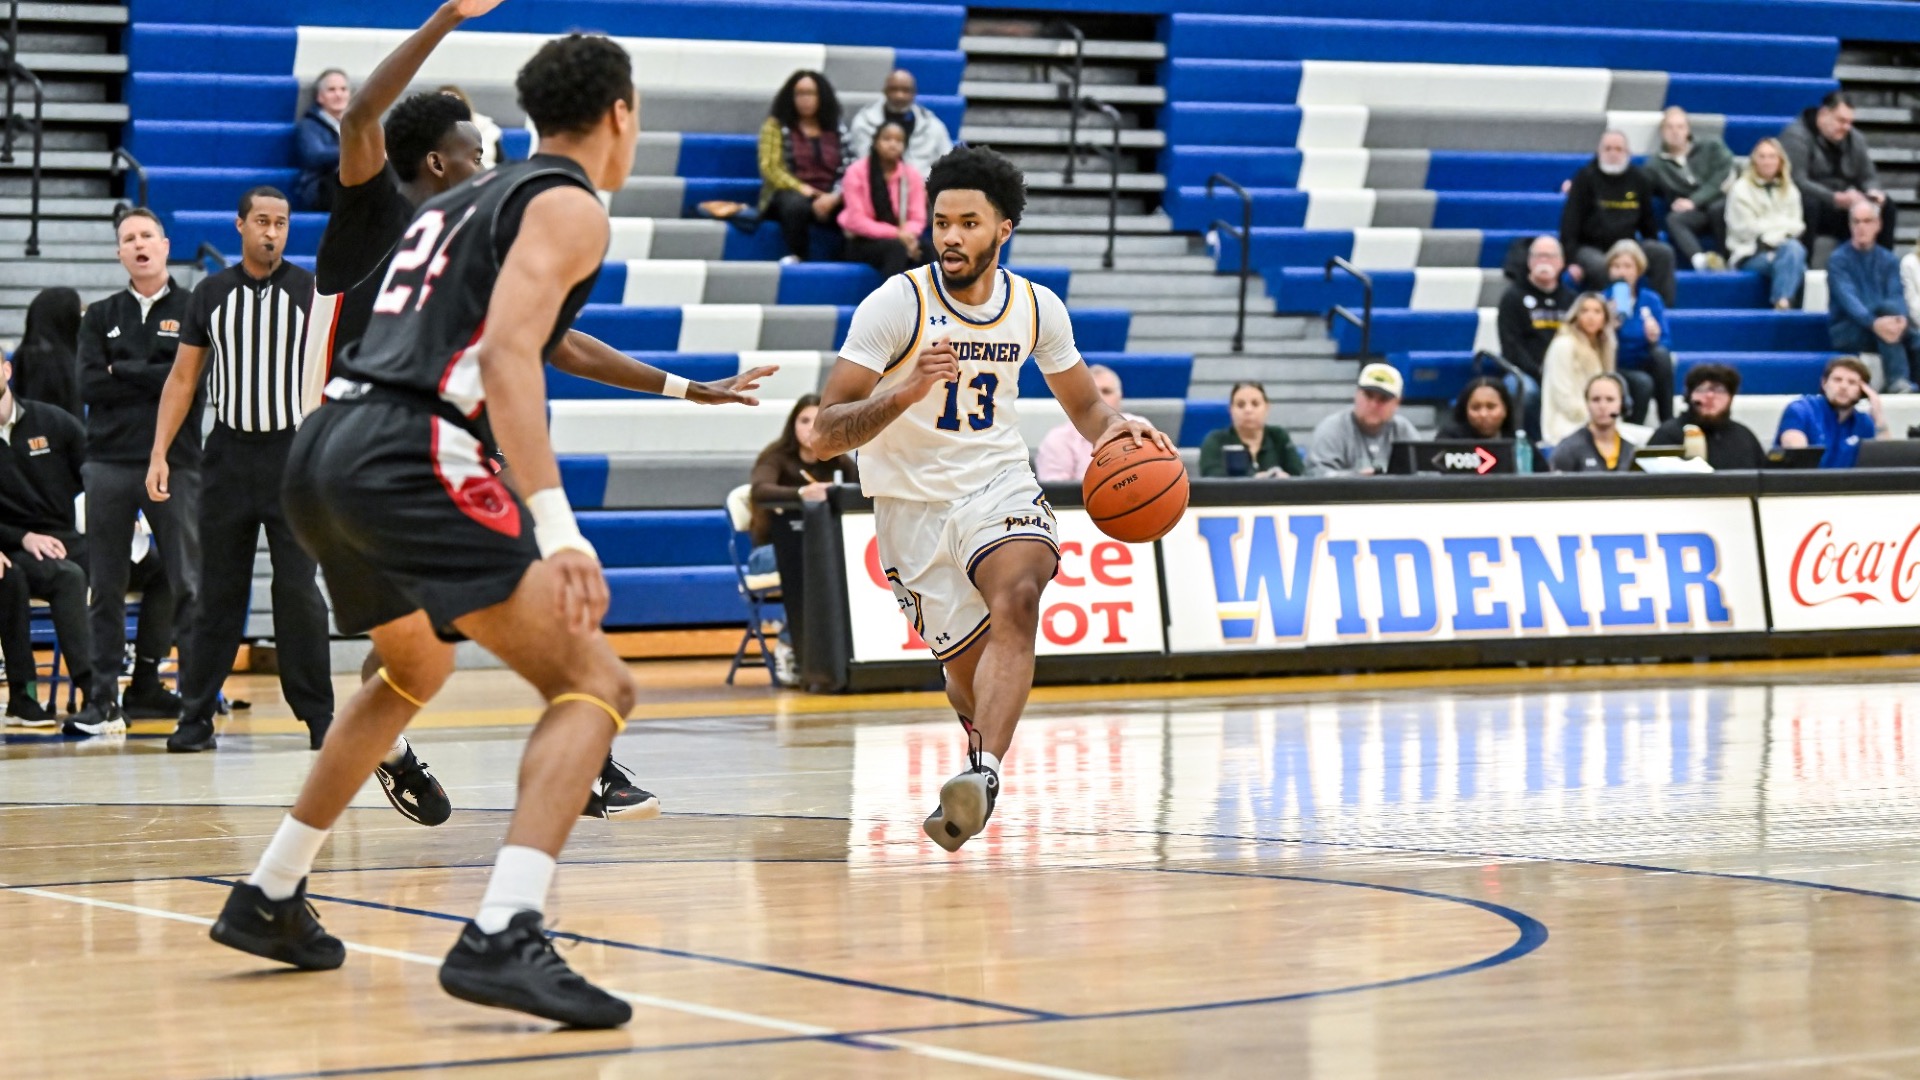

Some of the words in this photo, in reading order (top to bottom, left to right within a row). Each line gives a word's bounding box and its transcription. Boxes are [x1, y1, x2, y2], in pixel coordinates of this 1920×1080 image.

[932, 342, 1021, 362] DENER
[936, 371, 999, 432] 13
[1444, 452, 1482, 469] POSS
[1005, 515, 1052, 534] pride
[1197, 514, 1734, 645] WIDENER
